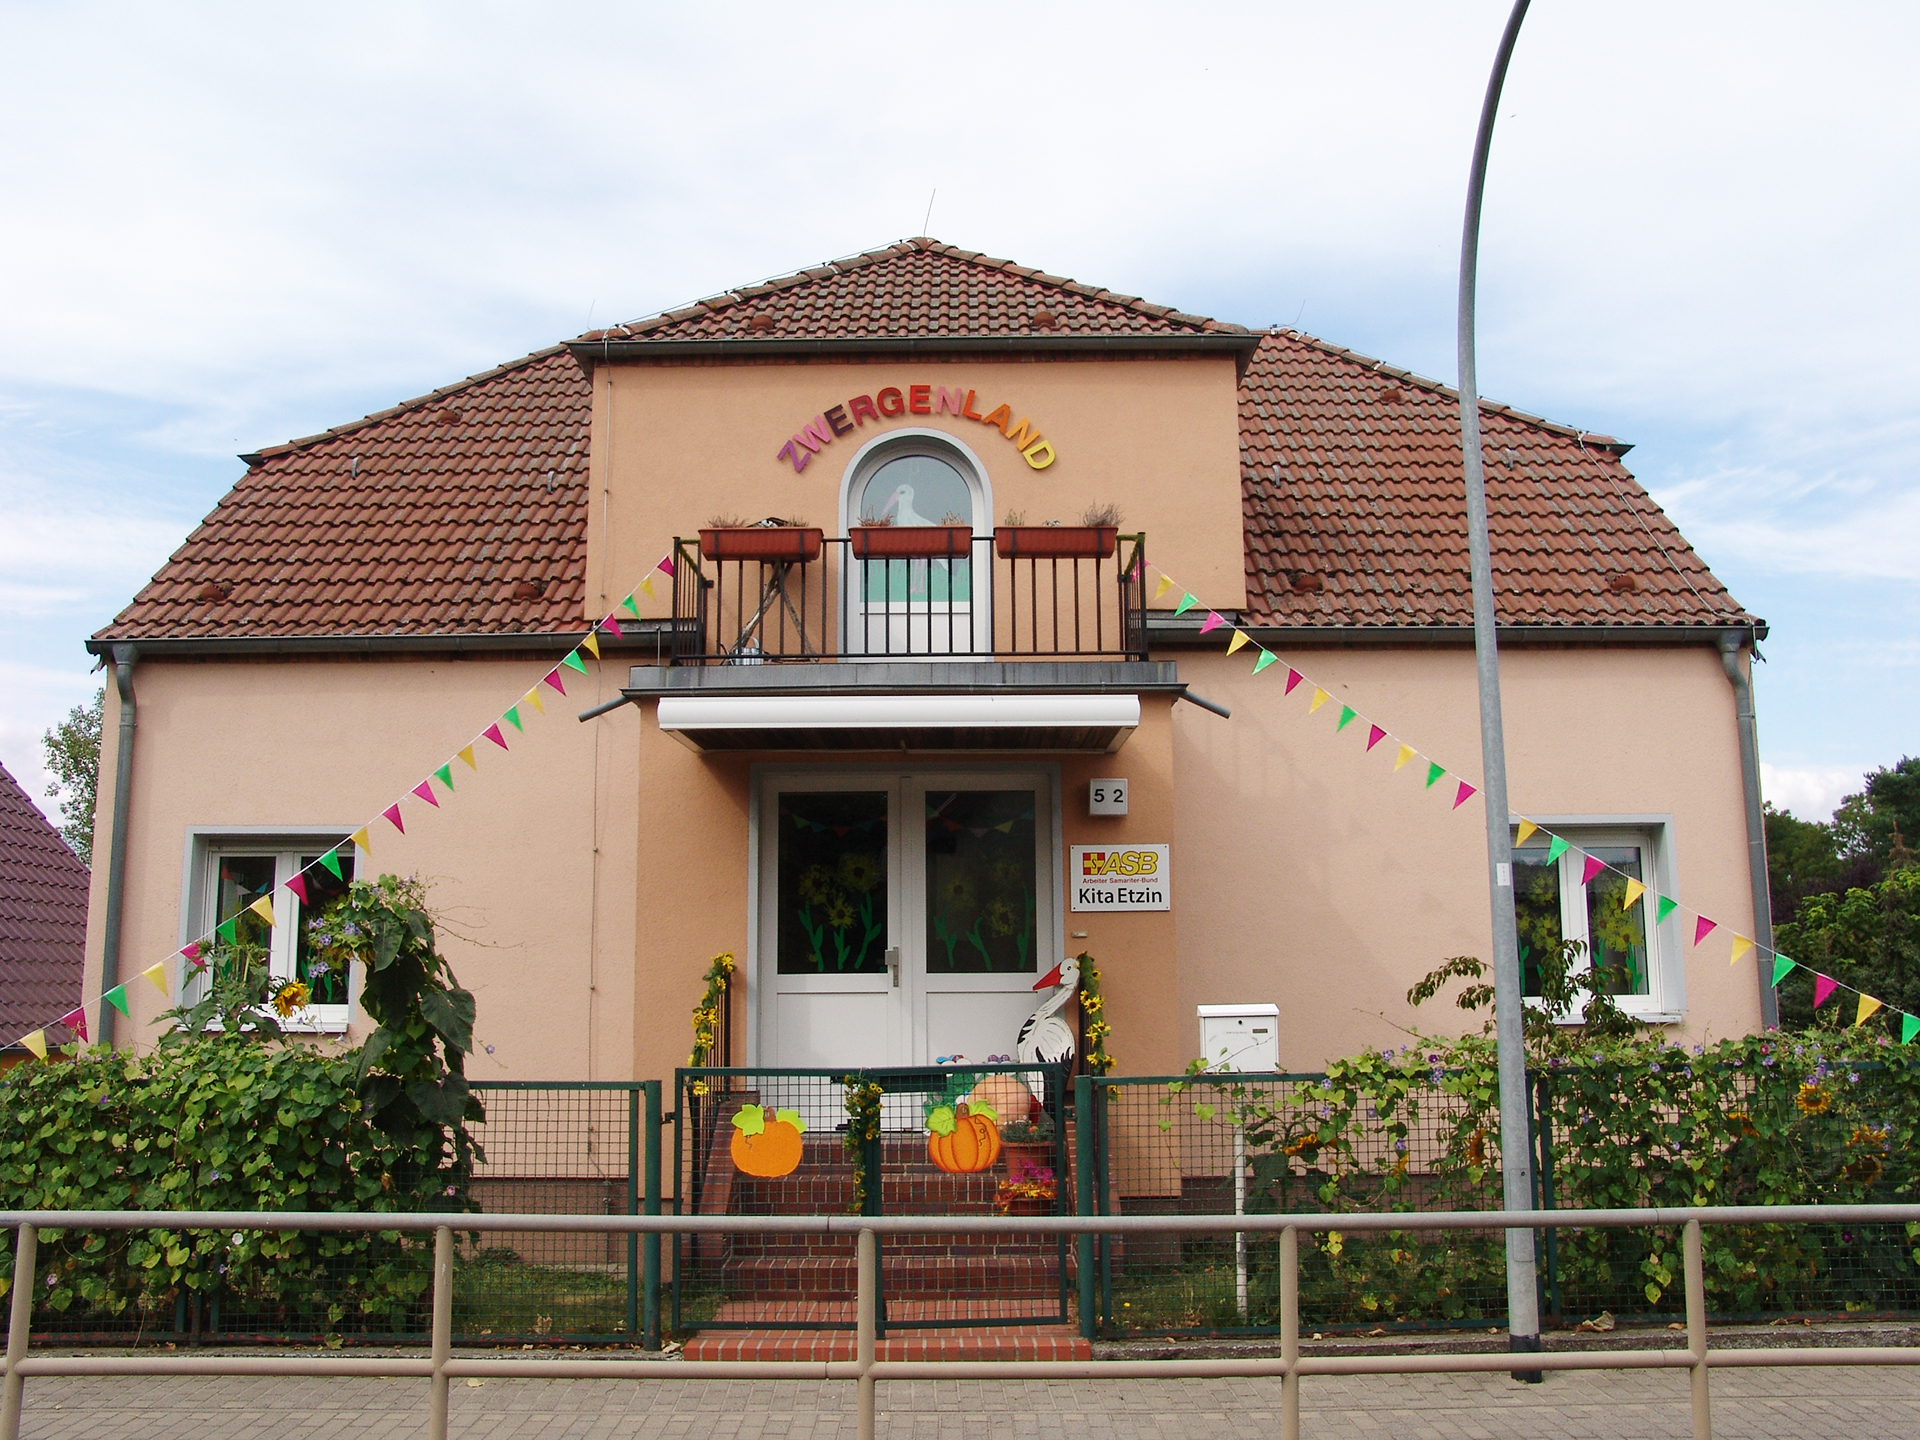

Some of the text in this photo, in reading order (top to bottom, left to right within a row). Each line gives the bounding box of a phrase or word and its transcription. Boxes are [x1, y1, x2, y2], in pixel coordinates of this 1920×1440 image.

[776, 385, 1057, 473] ZWERGENLAND
[1100, 851, 1159, 876] ASB
[1079, 887, 1162, 904] Kita Etzin
